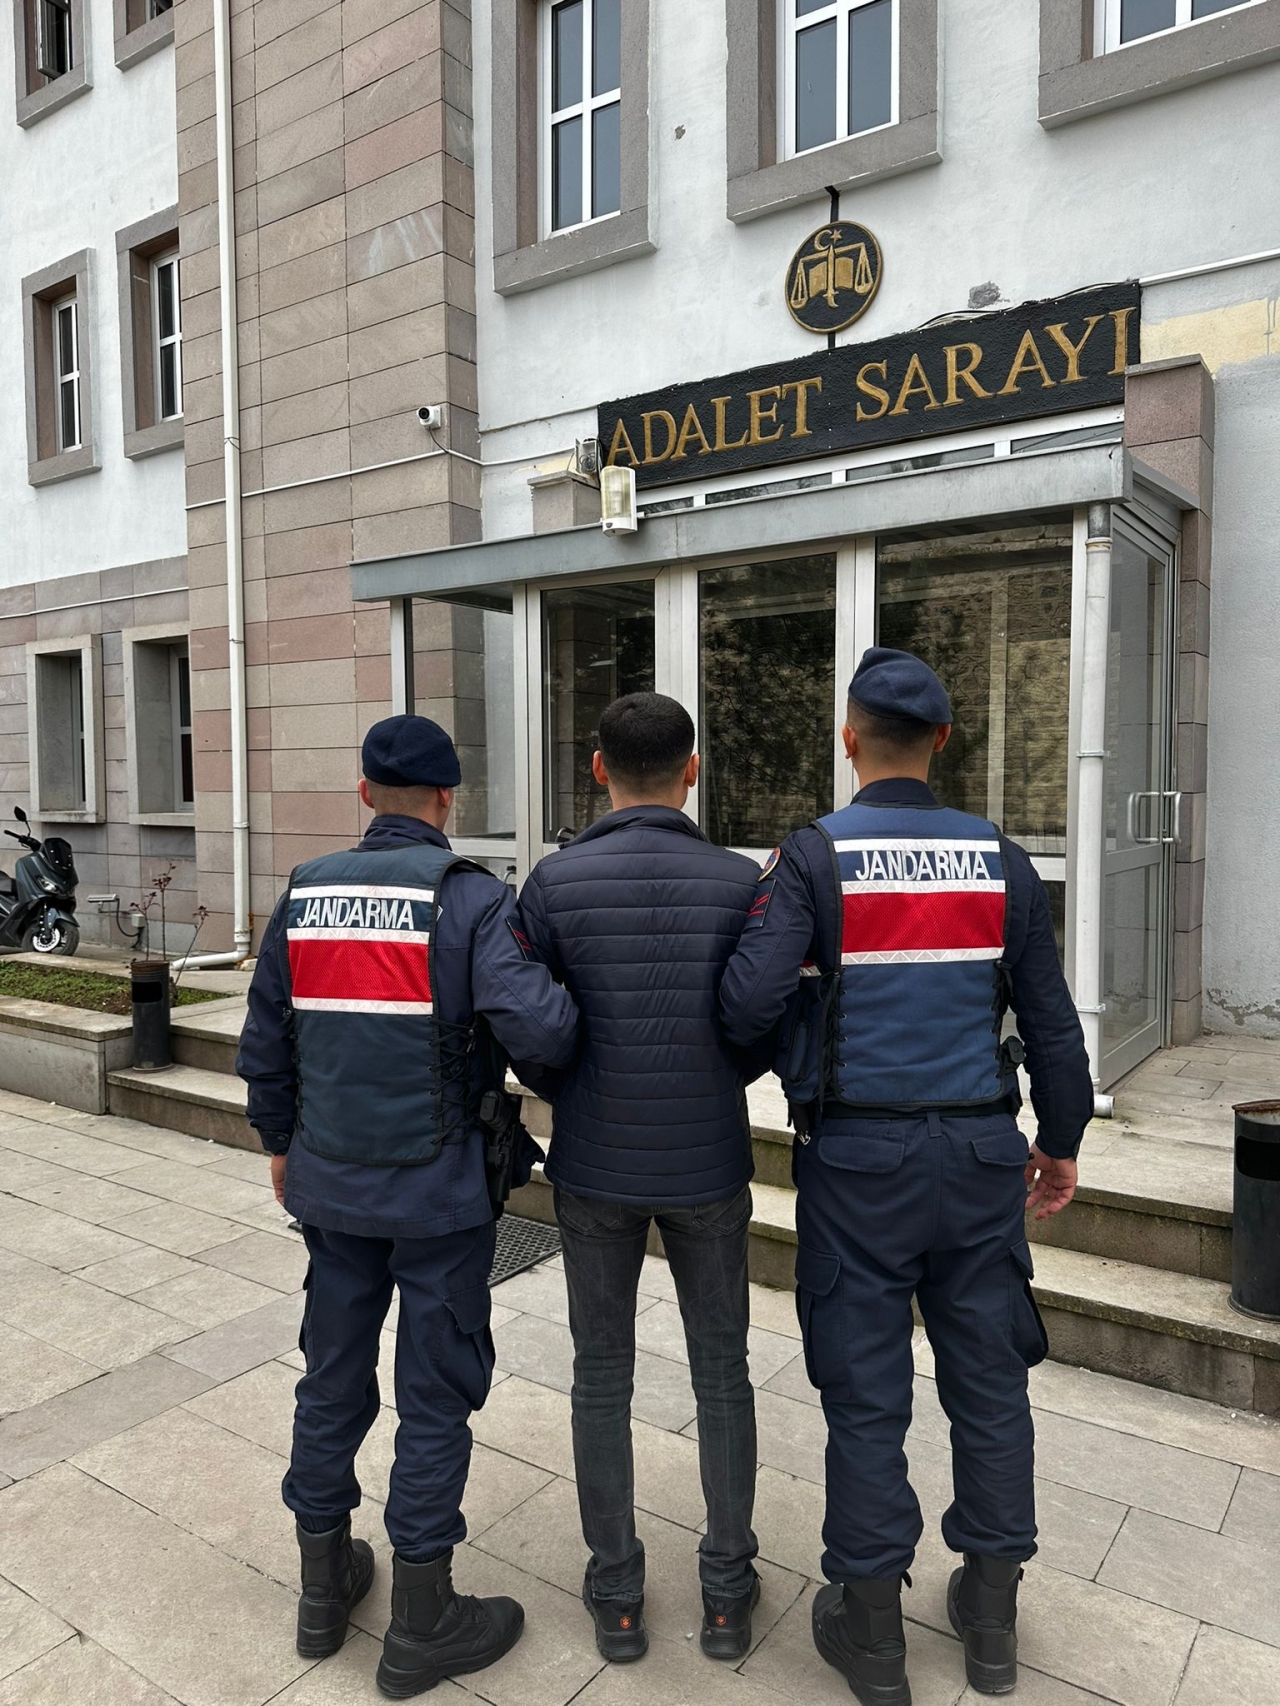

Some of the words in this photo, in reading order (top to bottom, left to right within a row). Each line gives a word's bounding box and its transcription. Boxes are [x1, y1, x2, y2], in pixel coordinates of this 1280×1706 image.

[607, 376, 822, 467] ADALET
[856, 307, 1137, 422] SARAYI
[855, 850, 991, 881] JANDARMA
[297, 897, 415, 930] JANDARMA
